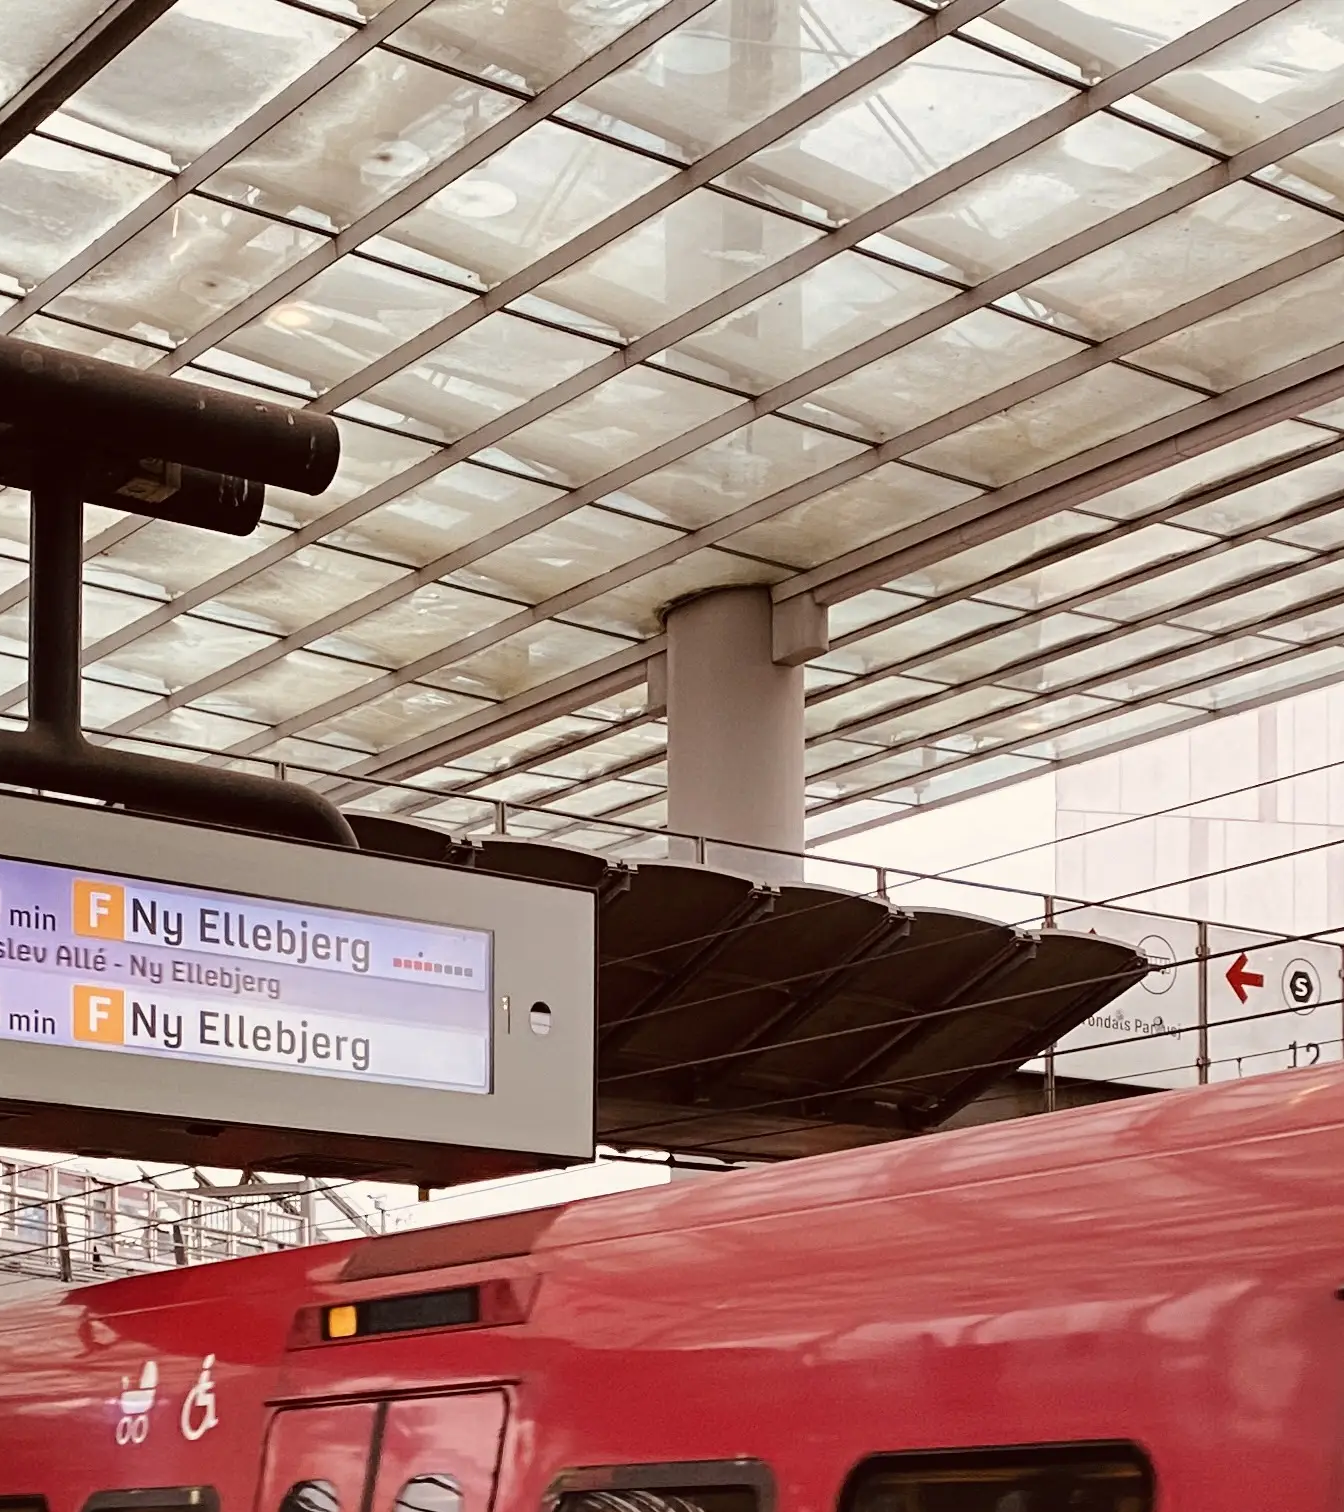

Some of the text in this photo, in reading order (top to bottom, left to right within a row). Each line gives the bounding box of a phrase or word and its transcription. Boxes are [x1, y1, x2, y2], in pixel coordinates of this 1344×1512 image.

[9, 905, 57, 932] min
[88, 891, 112, 929] F
[131, 897, 183, 946] Ny
[199, 907, 371, 973] Ellebjerg
[56, 945, 107, 972] Allé
[129, 954, 163, 984] Ny
[172, 960, 281, 1000] Ellebjerg
[9, 1009, 56, 1035] min
[88, 995, 112, 1033] F
[131, 1001, 183, 1049] Ny
[199, 1010, 371, 1071] Ellebjerg
